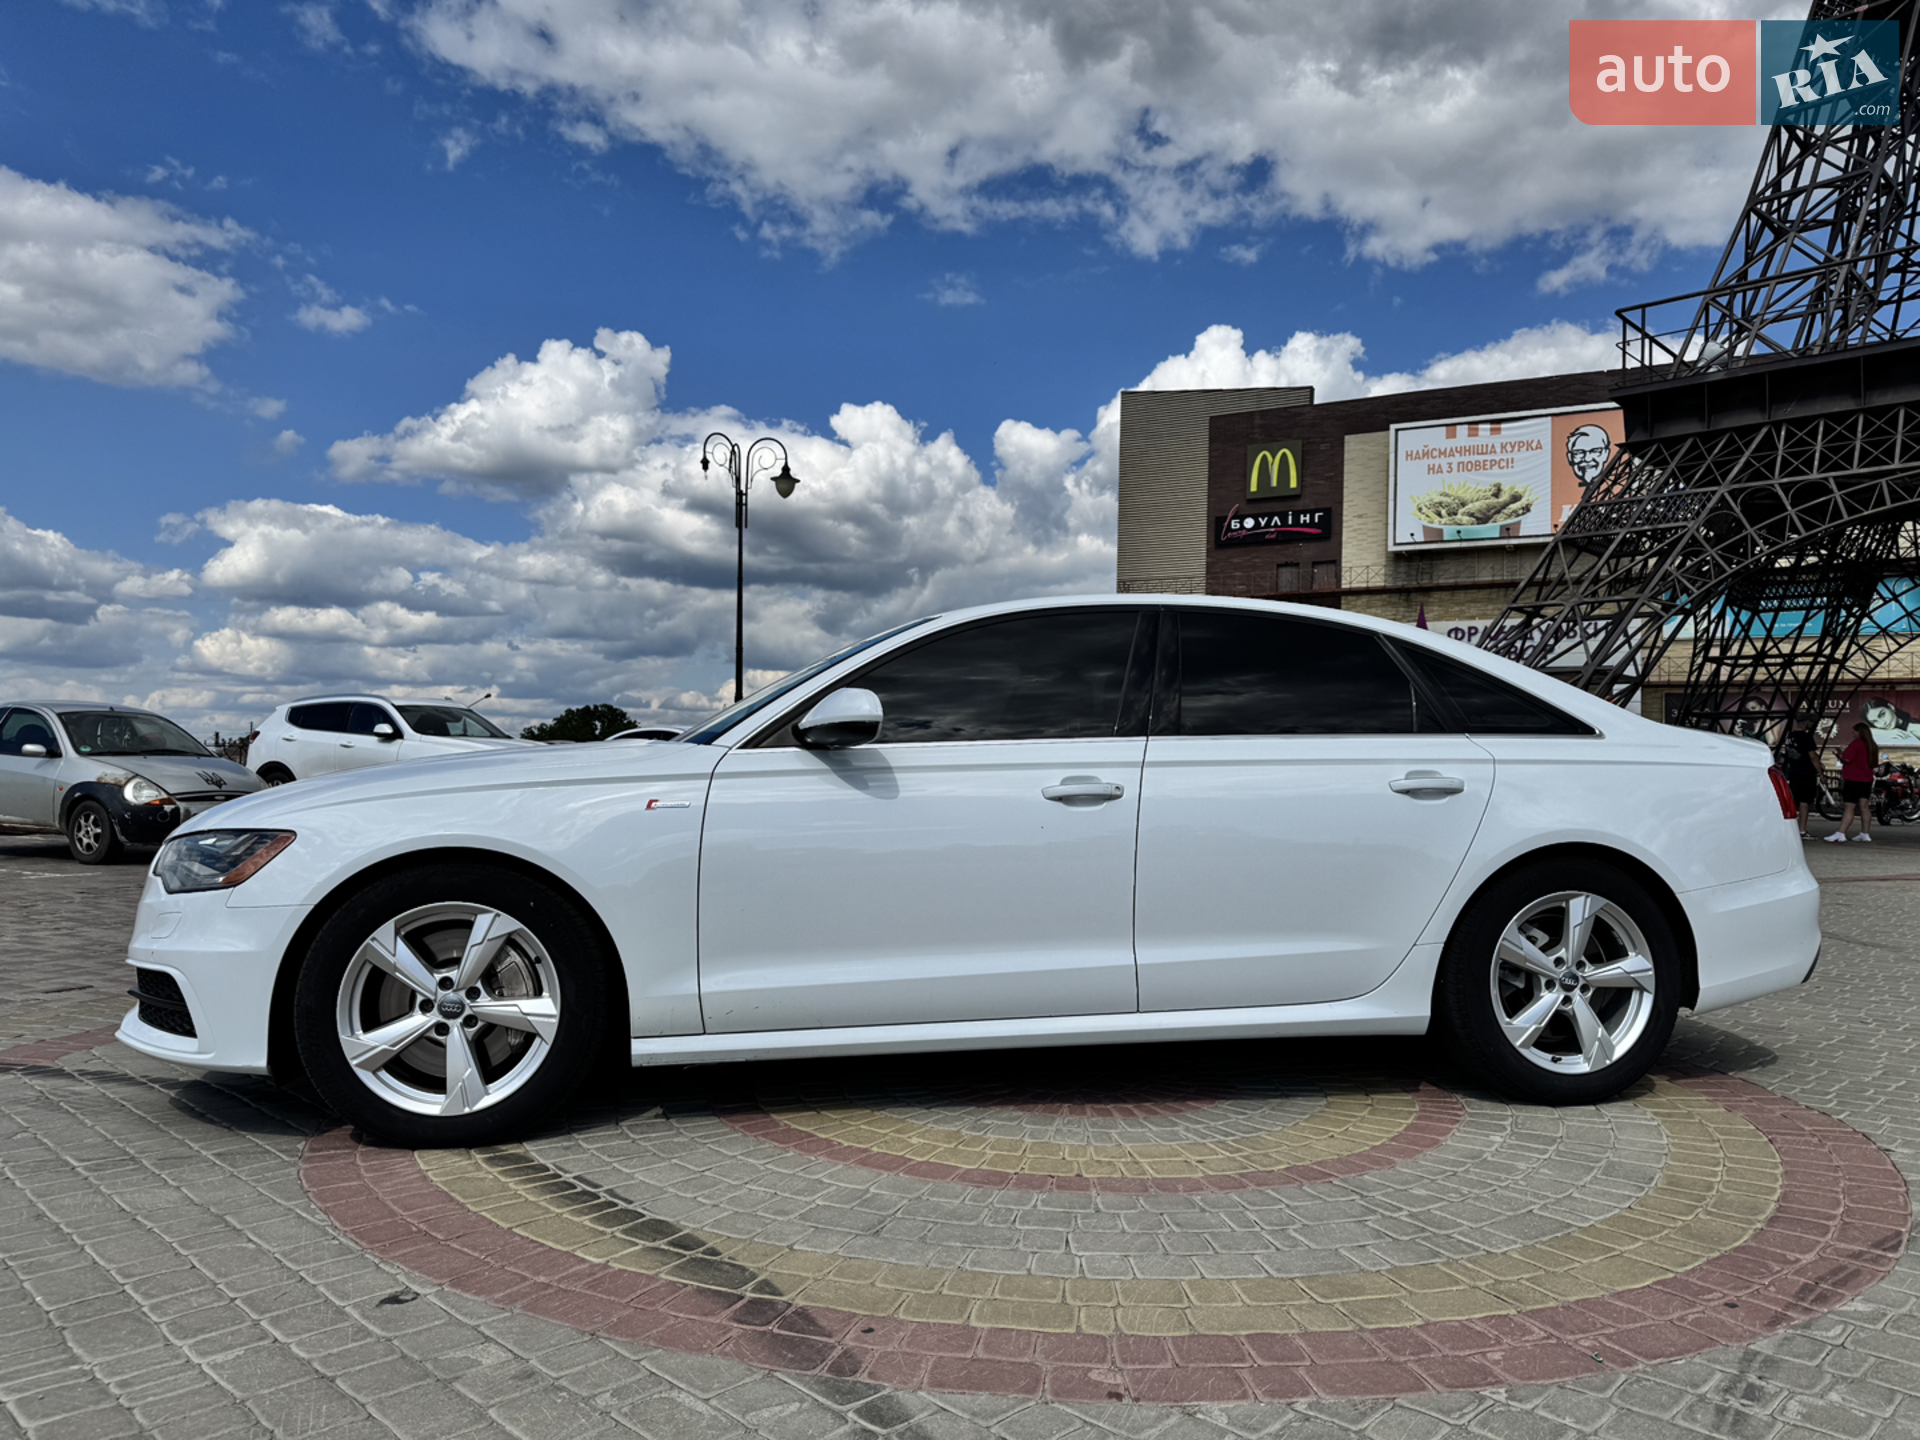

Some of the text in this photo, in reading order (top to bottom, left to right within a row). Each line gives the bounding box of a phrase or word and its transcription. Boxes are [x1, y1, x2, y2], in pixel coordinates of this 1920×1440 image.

[1405, 439, 1543, 462] НАЙСМАЧНІША КУРКА
[1427, 457, 1516, 475] НА 3 ПОВЕРСІ!
[1799, 699, 1851, 709] AUUM
